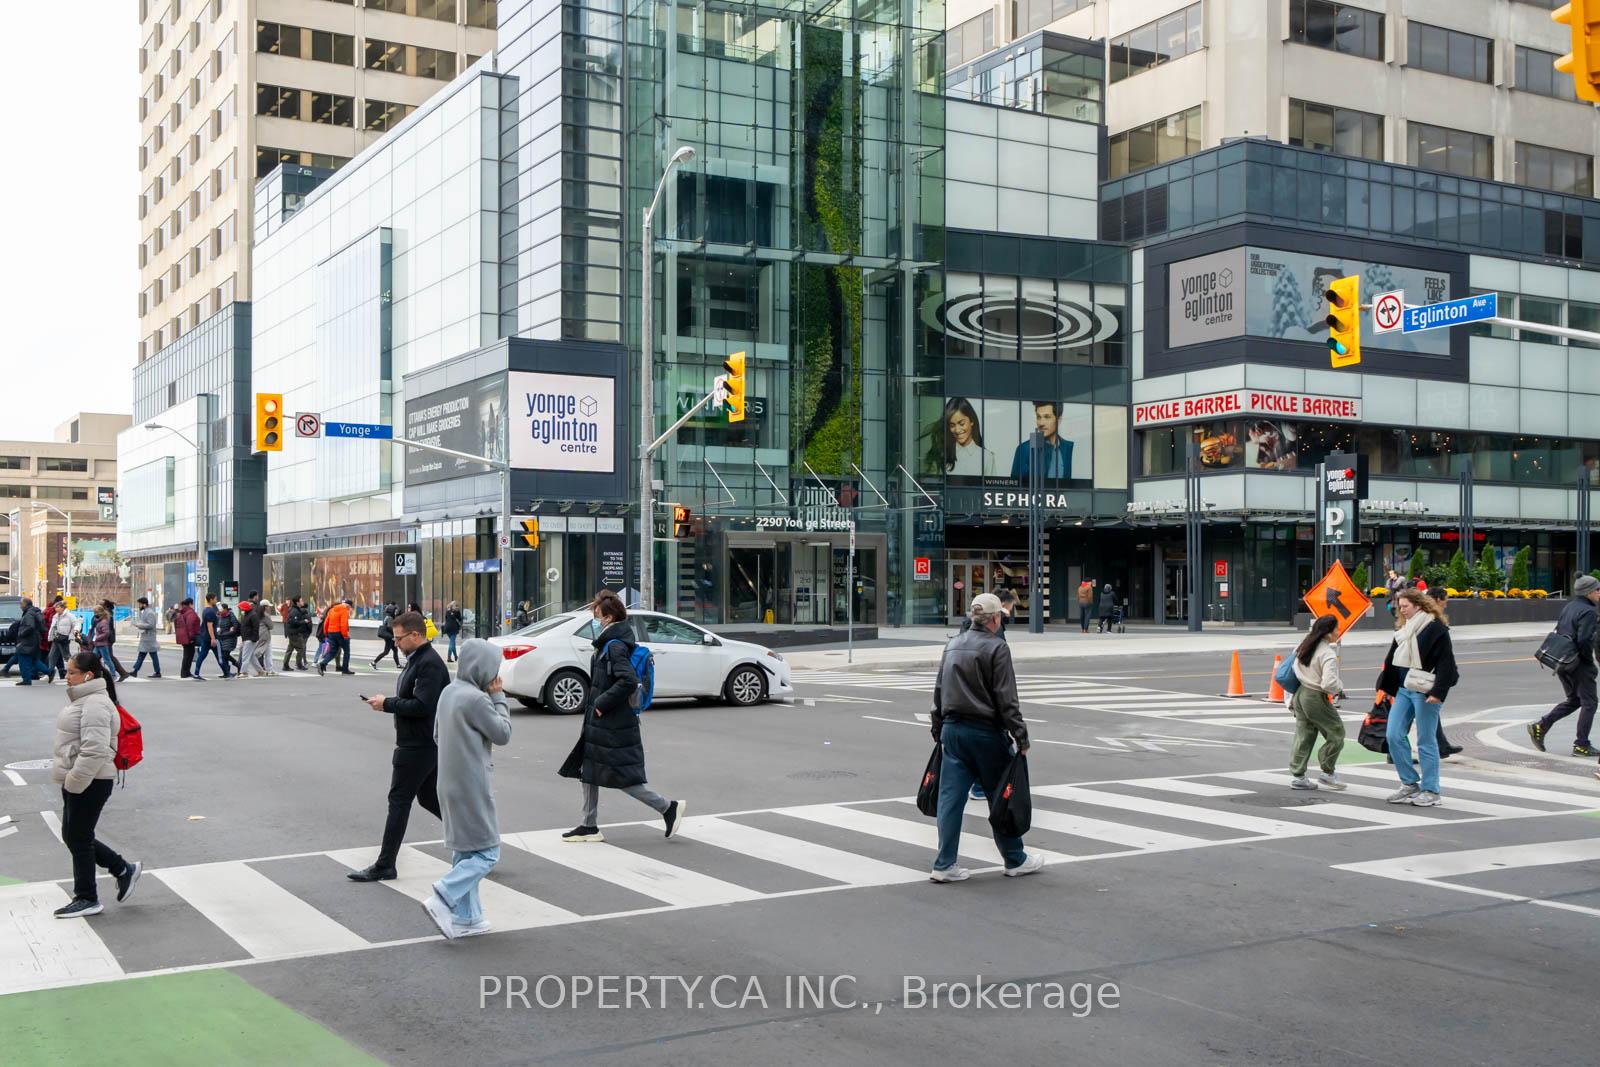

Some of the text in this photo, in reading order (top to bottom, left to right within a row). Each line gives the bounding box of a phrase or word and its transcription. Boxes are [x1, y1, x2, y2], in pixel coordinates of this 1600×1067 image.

[1181, 271, 1217, 300] yonge
[1424, 276, 1446, 289] FEELS
[1185, 291, 1233, 322] eglinton
[1205, 313, 1233, 325] centre
[1411, 298, 1487, 329] Eglinton Ave
[427, 404, 443, 420] ENERGY
[443, 396, 470, 415] PRODUCTION
[526, 393, 576, 419] yonge
[1136, 394, 1241, 422] PICKLE BARREL
[1251, 393, 1298, 413] PICKLE
[438, 414, 461, 431] GROCERIES
[339, 424, 371, 437] Yonge
[531, 415, 598, 444] eglinton
[560, 442, 597, 454] centre
[1326, 470, 1345, 481] yonge
[103, 506, 113, 518] P
[756, 517, 783, 528] 2290
[820, 518, 851, 529] Street
[1326, 507, 1345, 536] P
[1418, 531, 1441, 540] aroma
[917, 561, 927, 572] R
[1217, 565, 1225, 575] R
[196, 574, 208, 582] 50
